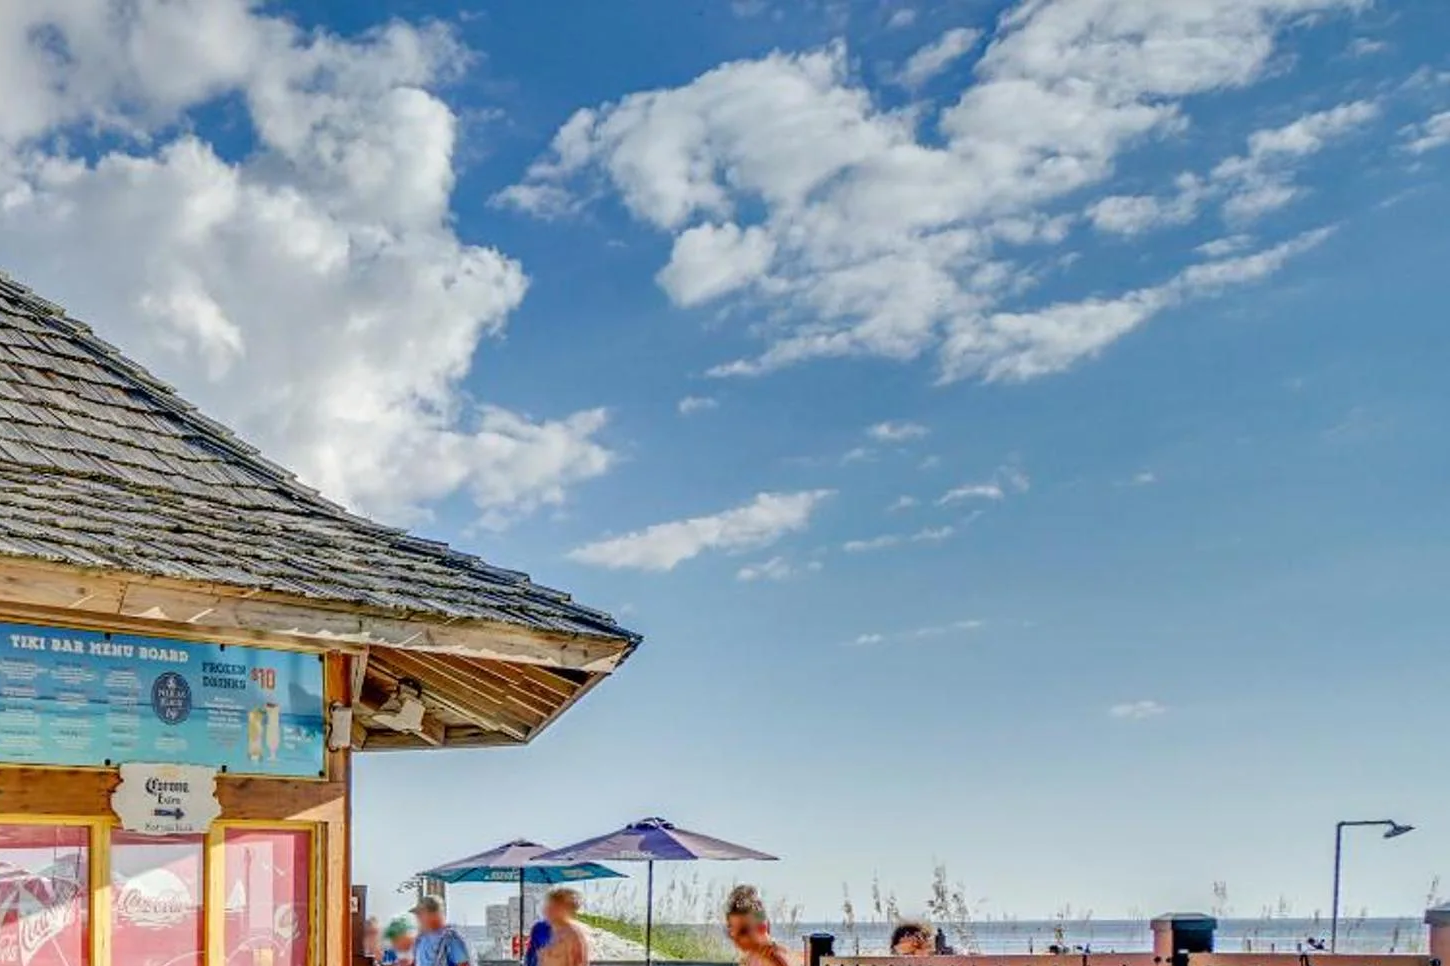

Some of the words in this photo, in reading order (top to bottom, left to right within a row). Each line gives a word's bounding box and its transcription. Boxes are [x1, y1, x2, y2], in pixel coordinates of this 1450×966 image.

[10, 634, 46, 650] TIKI
[51, 638, 84, 654] BAR
[89, 641, 134, 658] MENU
[138, 646, 189, 664] BOARD
[251, 667, 276, 690] $10
